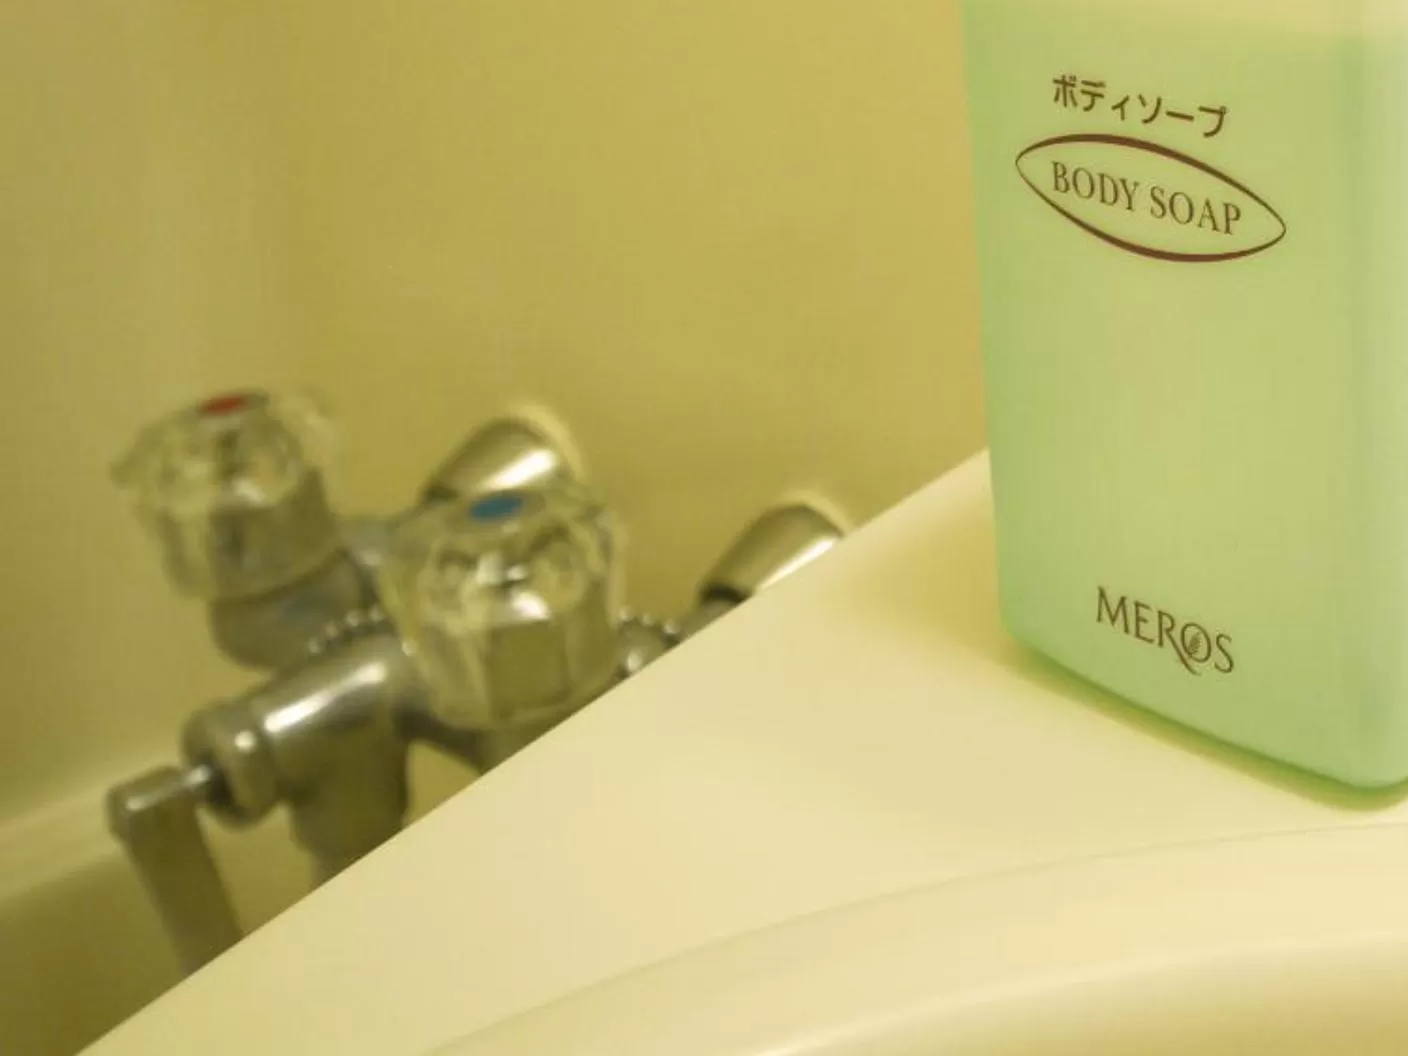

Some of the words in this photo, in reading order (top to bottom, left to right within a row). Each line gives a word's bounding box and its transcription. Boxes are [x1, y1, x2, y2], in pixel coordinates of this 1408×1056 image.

[1052, 73, 1229, 138] ボディソープ
[1051, 160, 1141, 212] BODY
[1149, 185, 1242, 235] SOAP
[1096, 584, 1235, 677] MEROS
